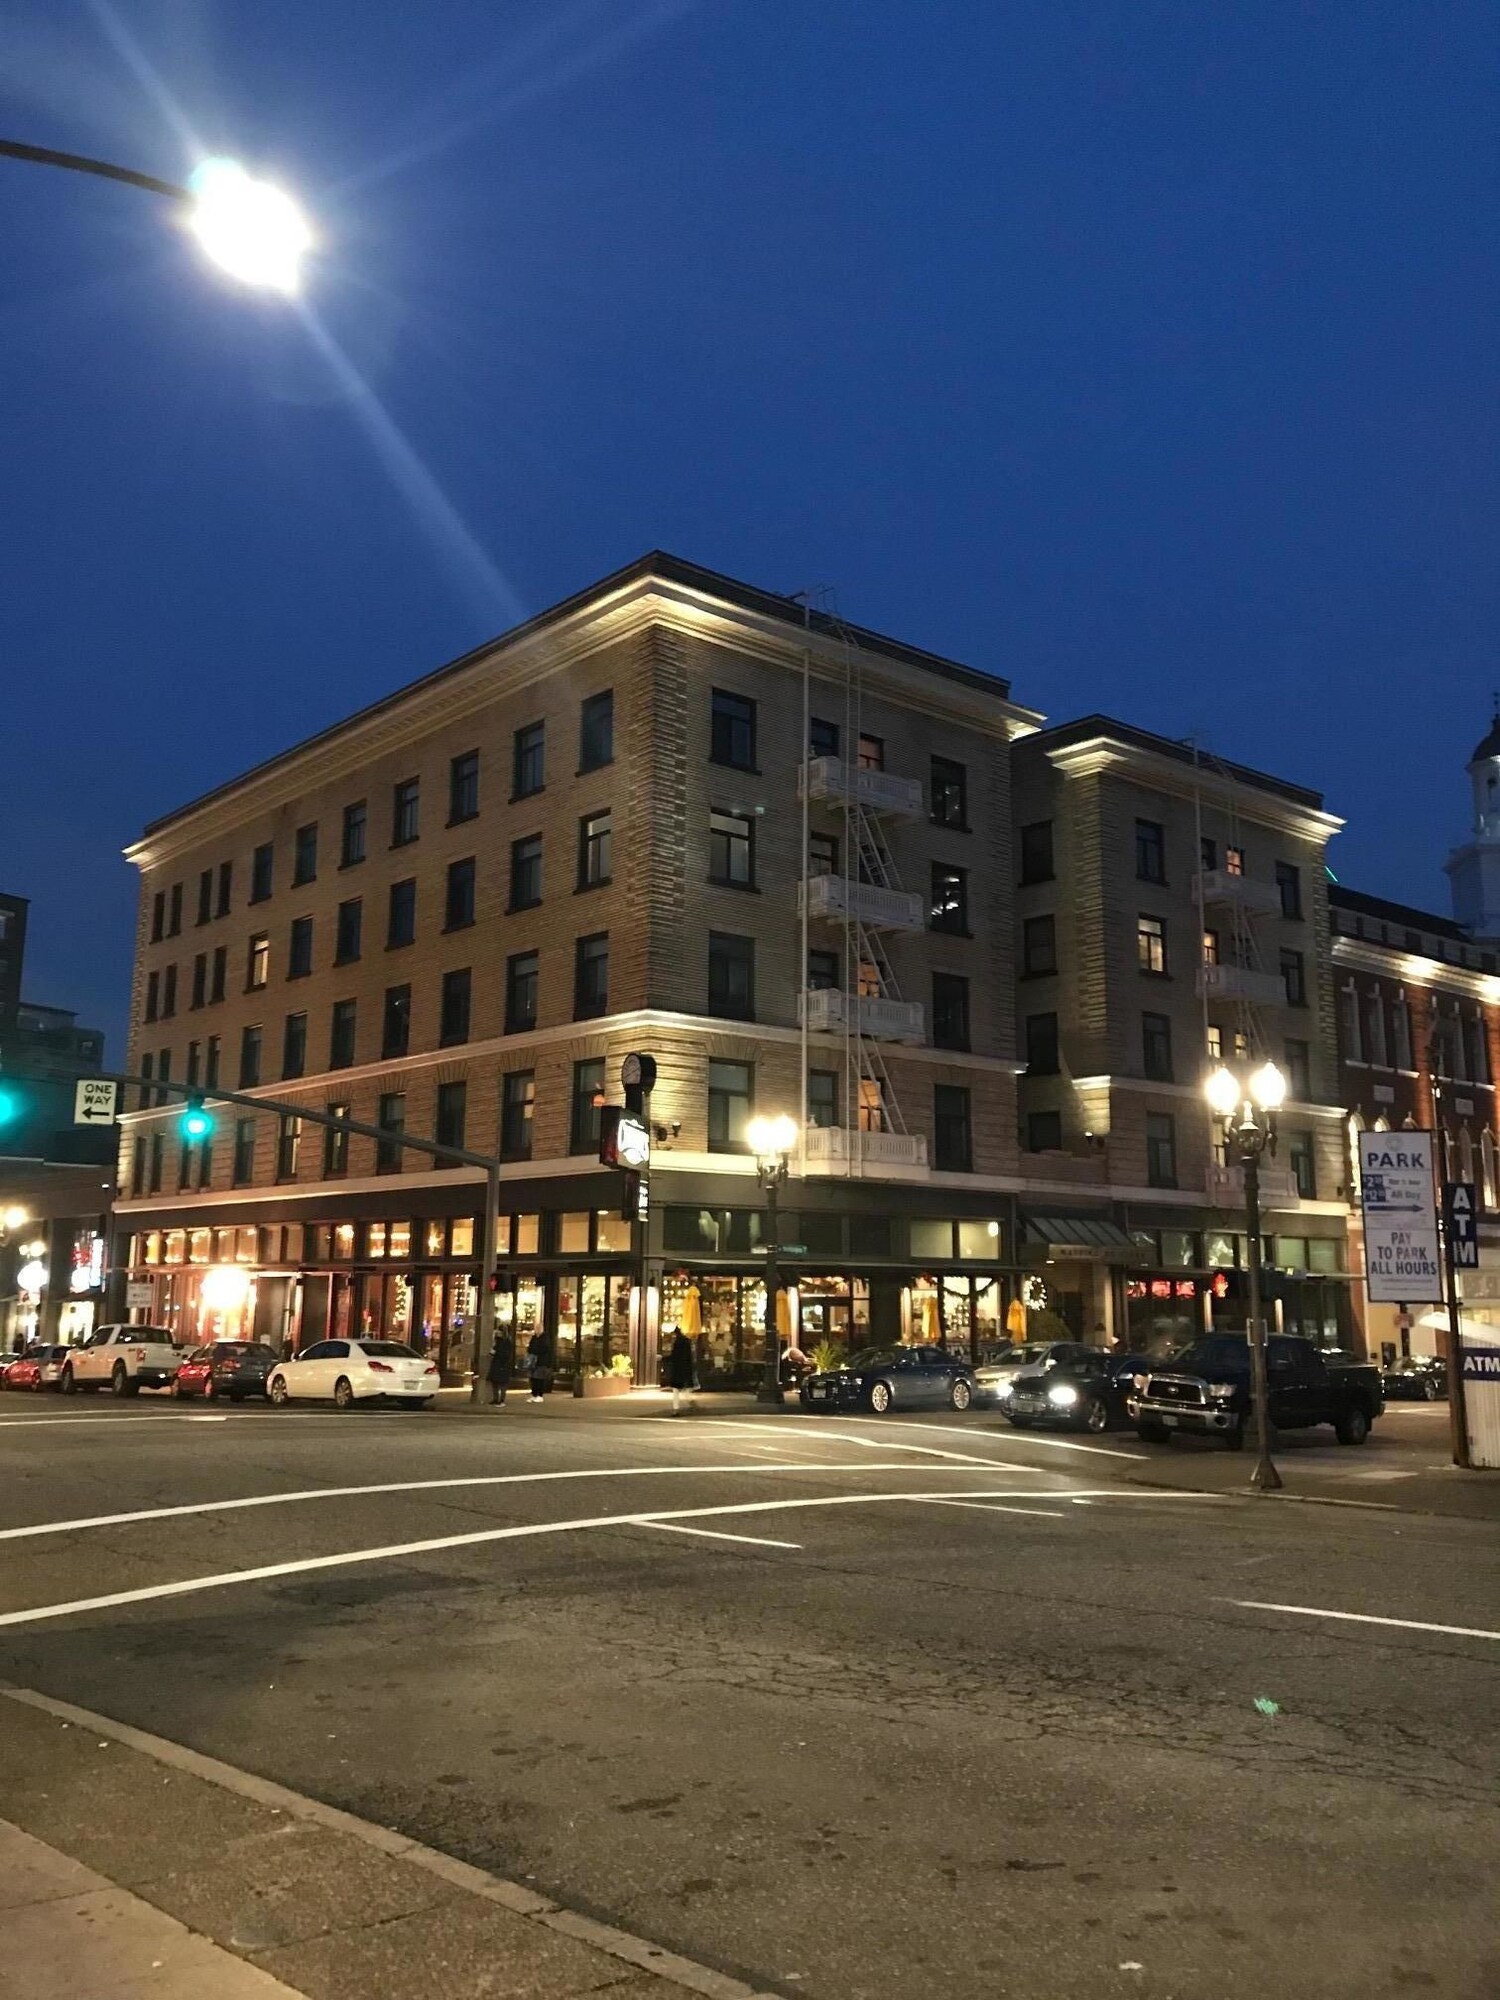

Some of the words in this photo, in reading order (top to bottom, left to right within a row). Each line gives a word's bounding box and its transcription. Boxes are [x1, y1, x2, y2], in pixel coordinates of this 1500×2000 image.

[85, 1083, 112, 1094] ONE
[84, 1095, 111, 1105] WAY
[1367, 1152, 1425, 1168] PARK
[1452, 1186, 1476, 1264] ATM
[1391, 1232, 1411, 1245] PAY
[1377, 1245, 1393, 1260] TO
[1396, 1246, 1428, 1261] PARK
[1371, 1261, 1393, 1275] ALL
[1395, 1261, 1438, 1275] HOURS
[1463, 1356, 1500, 1373] ATM
